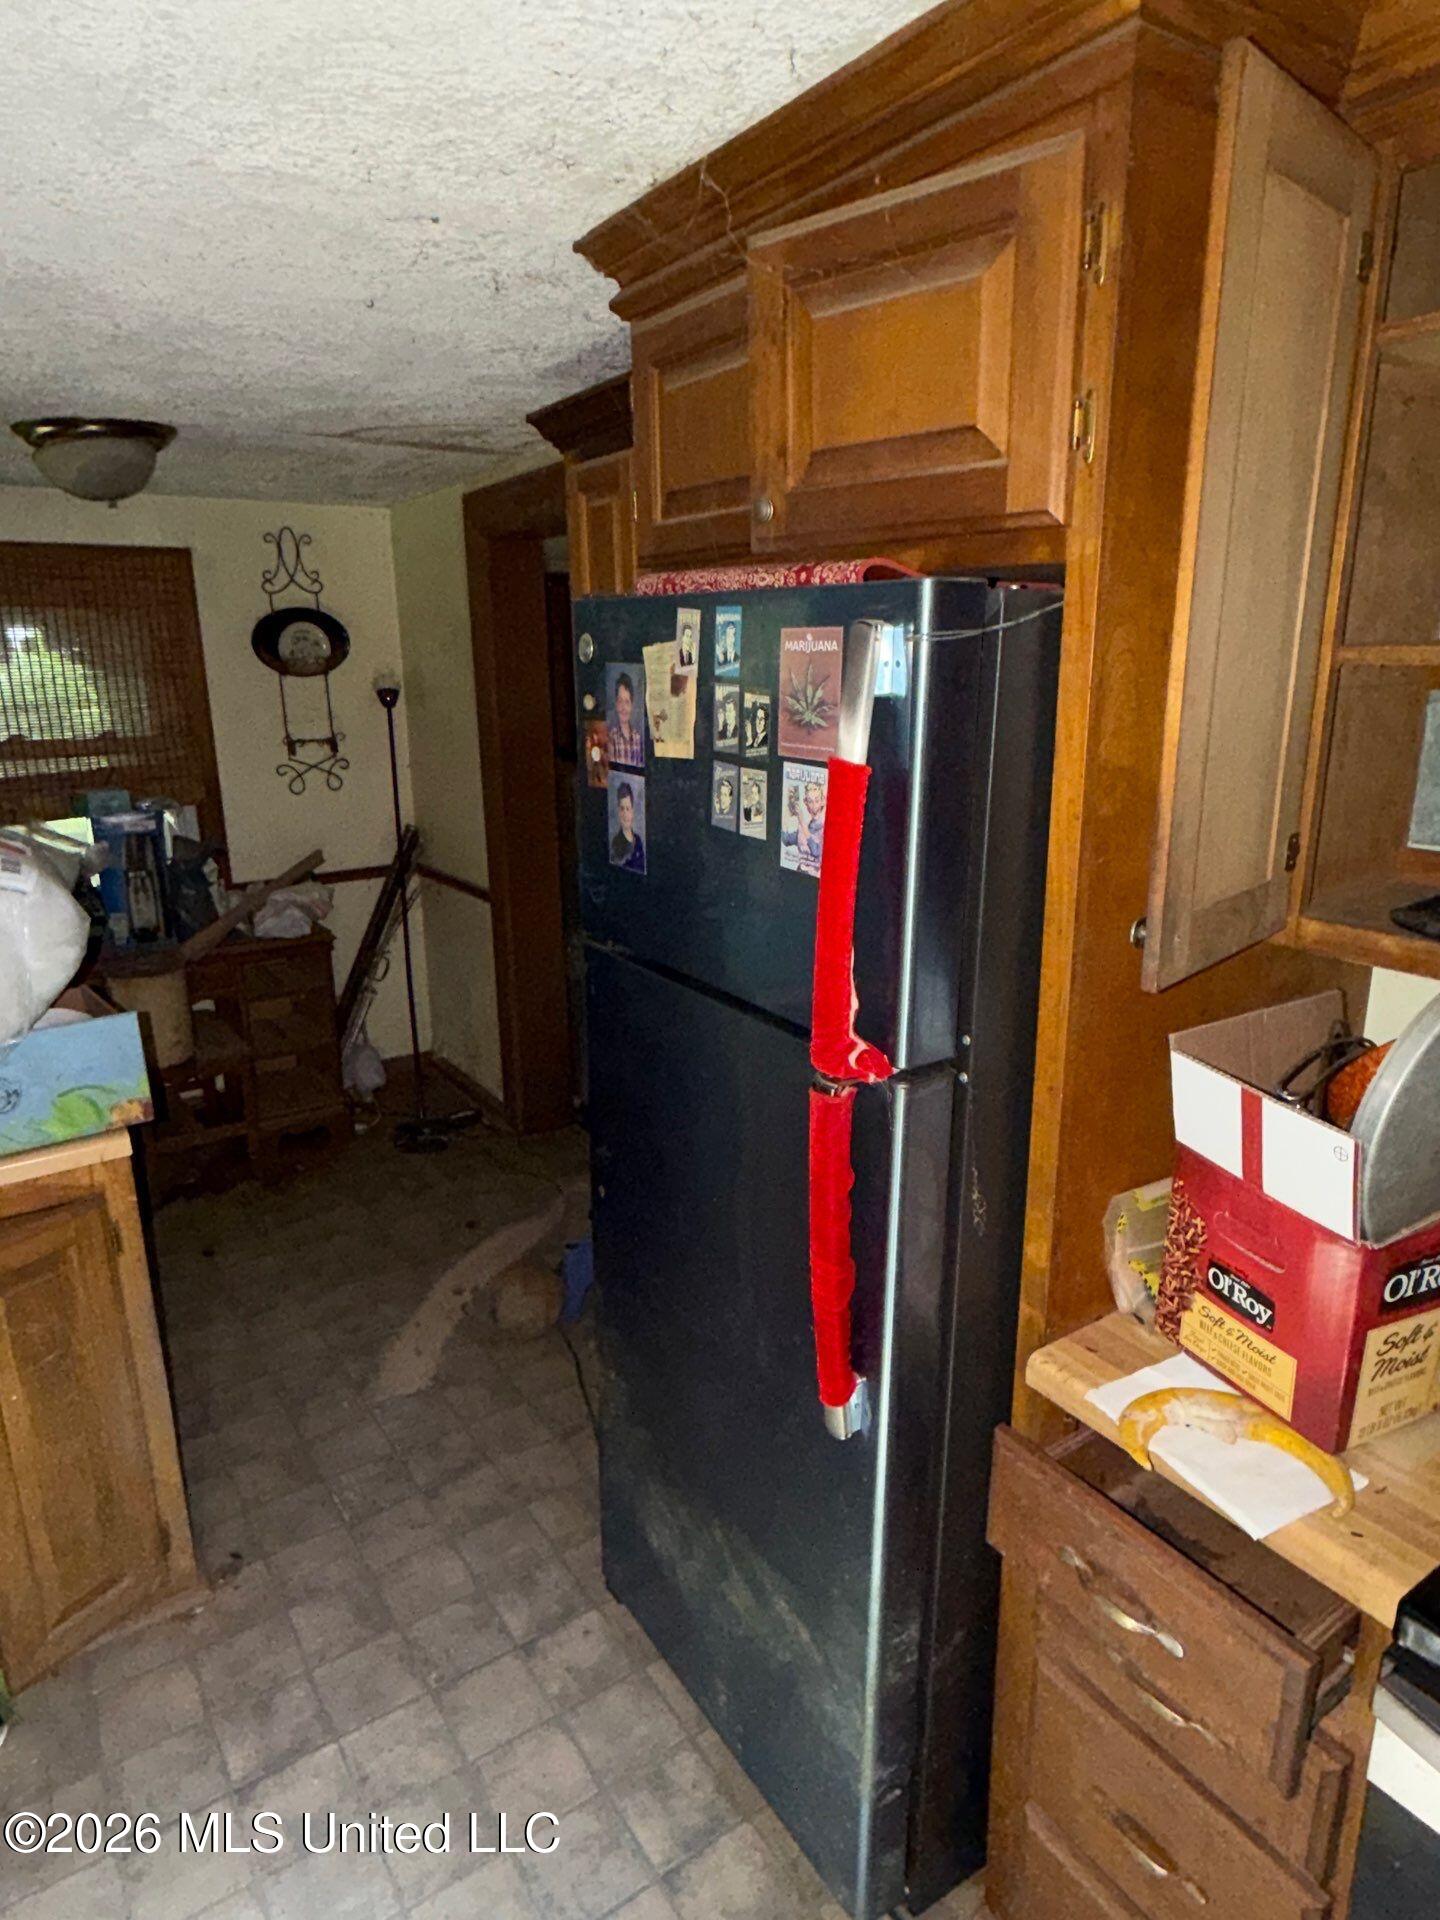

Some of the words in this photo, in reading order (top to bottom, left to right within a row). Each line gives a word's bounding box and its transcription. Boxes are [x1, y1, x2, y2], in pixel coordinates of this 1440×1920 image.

[784, 634, 838, 653] MARIJUANA
[1199, 1305, 1224, 1328] Soft
[1236, 1329, 1277, 1365] Moist
[1376, 1323, 1423, 1356] Soft
[1371, 1344, 1431, 1382] Moist
